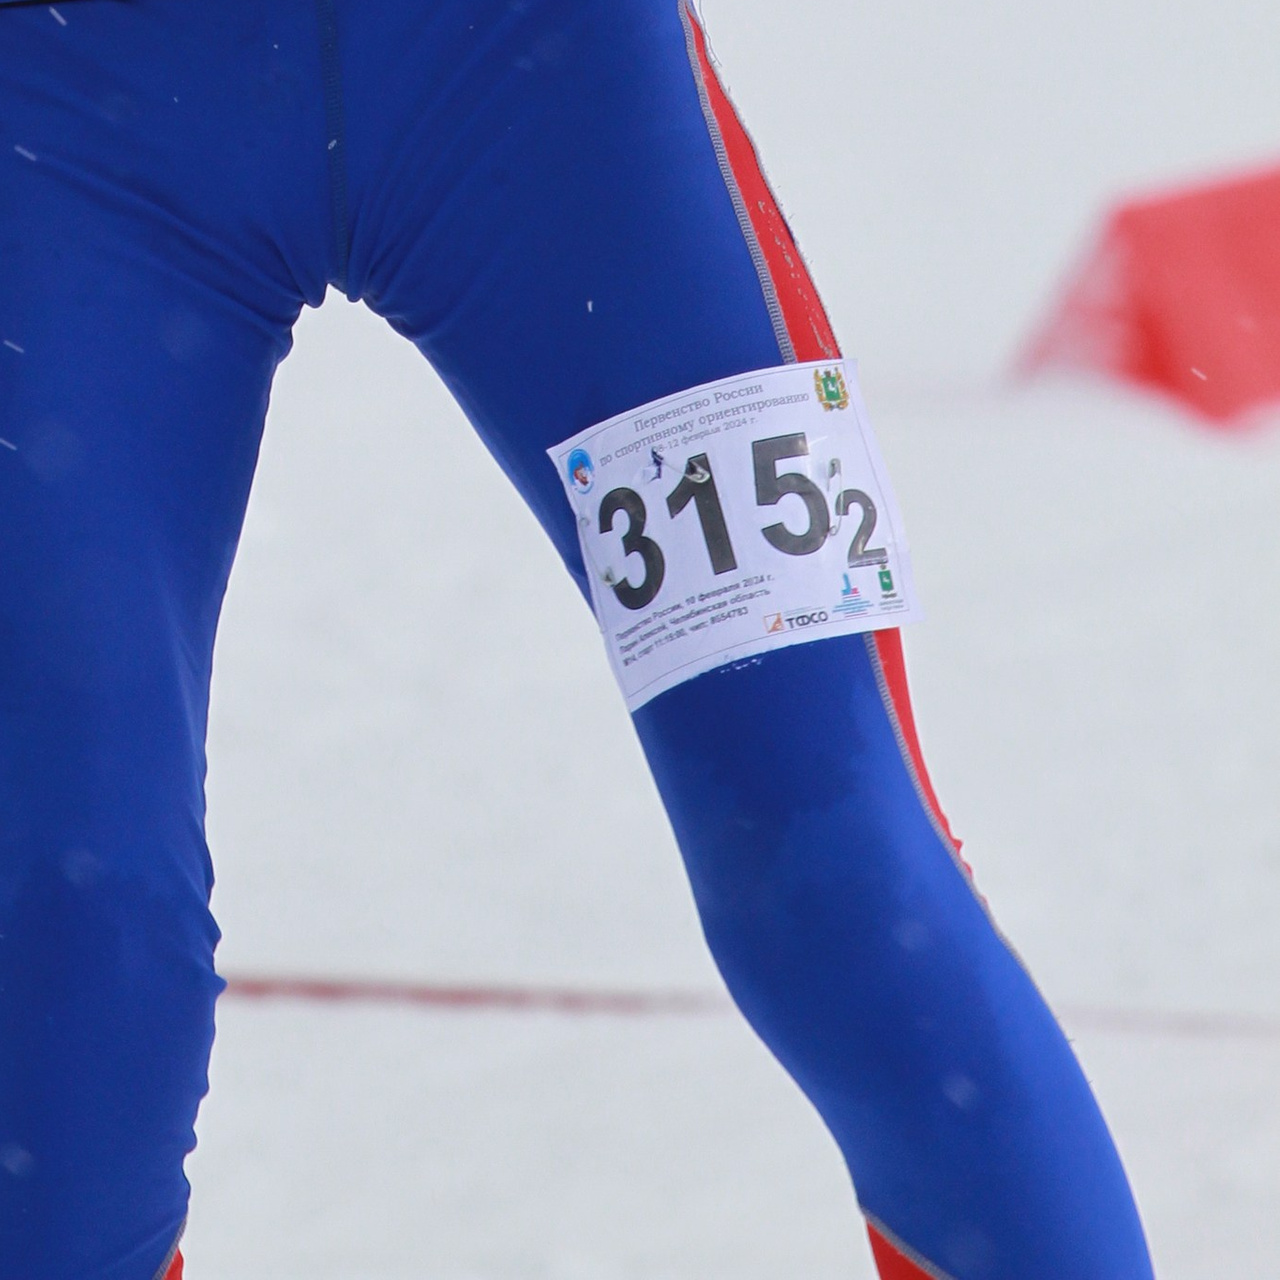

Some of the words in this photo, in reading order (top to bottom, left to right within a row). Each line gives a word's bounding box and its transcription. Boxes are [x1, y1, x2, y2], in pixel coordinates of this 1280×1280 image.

[600, 455, 613, 467] по
[614, 418, 695, 459] спортивному
[698, 392, 810, 426] ориентированию
[634, 397, 710, 432] Первенство
[714, 384, 763, 404] России
[723, 417, 748, 431] 2024
[598, 432, 831, 611] 315
[835, 489, 888, 568] 2
